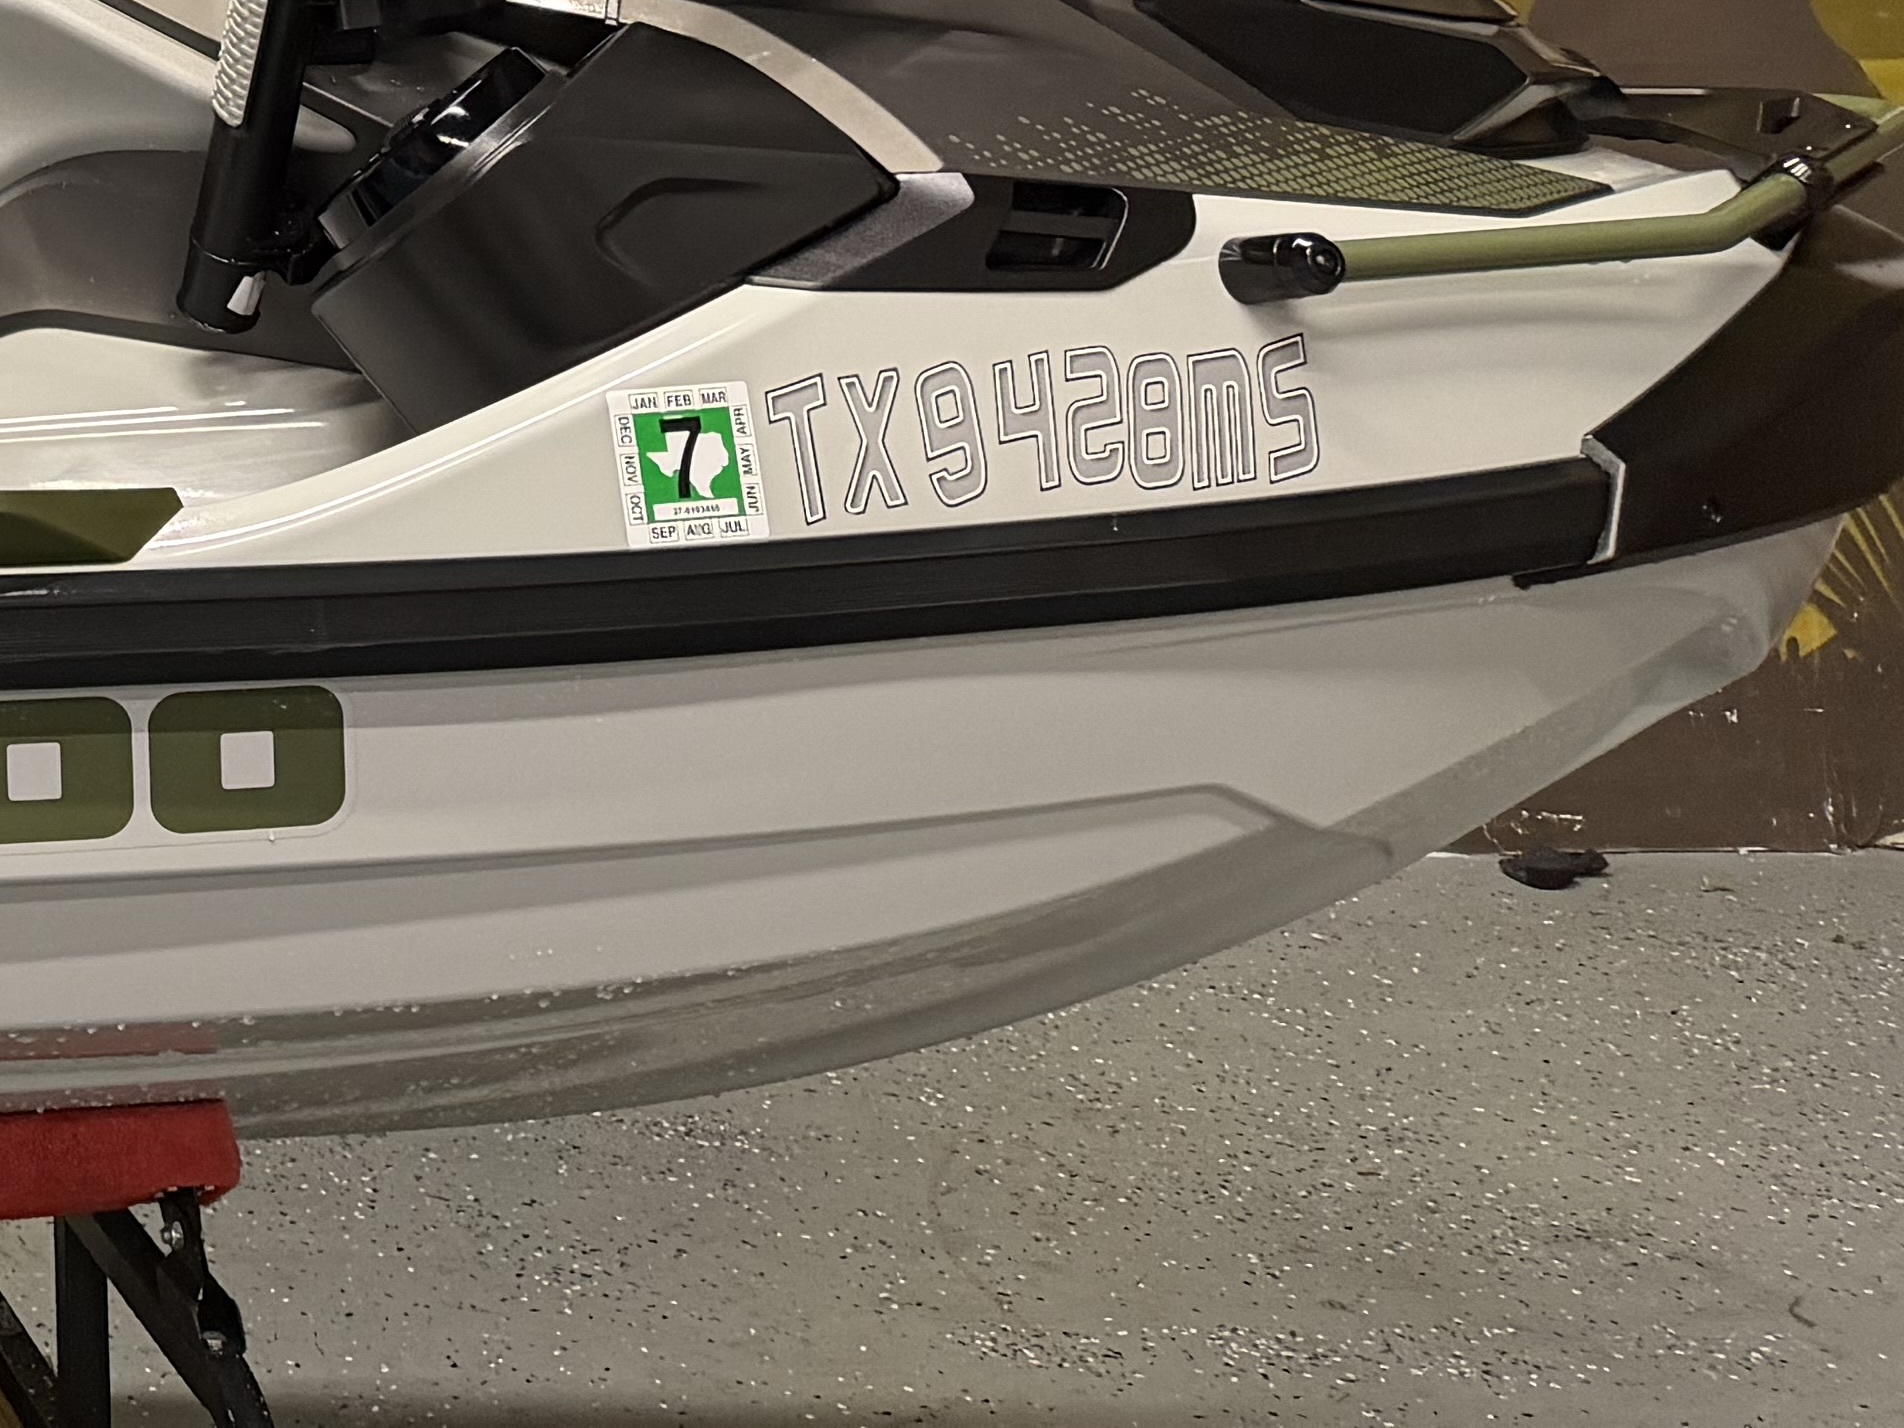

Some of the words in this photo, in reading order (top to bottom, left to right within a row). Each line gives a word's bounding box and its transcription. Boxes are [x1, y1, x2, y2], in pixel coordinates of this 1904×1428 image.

[632, 396, 658, 409] JAN
[667, 394, 692, 407] FEB
[701, 391, 727, 404] MAR
[617, 416, 633, 444] DEC
[733, 407, 748, 435] APR
[624, 455, 639, 484] NOV
[659, 416, 702, 499] 7
[739, 446, 754, 476] MAY
[629, 494, 644, 522] OCT
[746, 485, 760, 513] JUN
[651, 525, 677, 539] SEP
[720, 520, 746, 534] JUL
